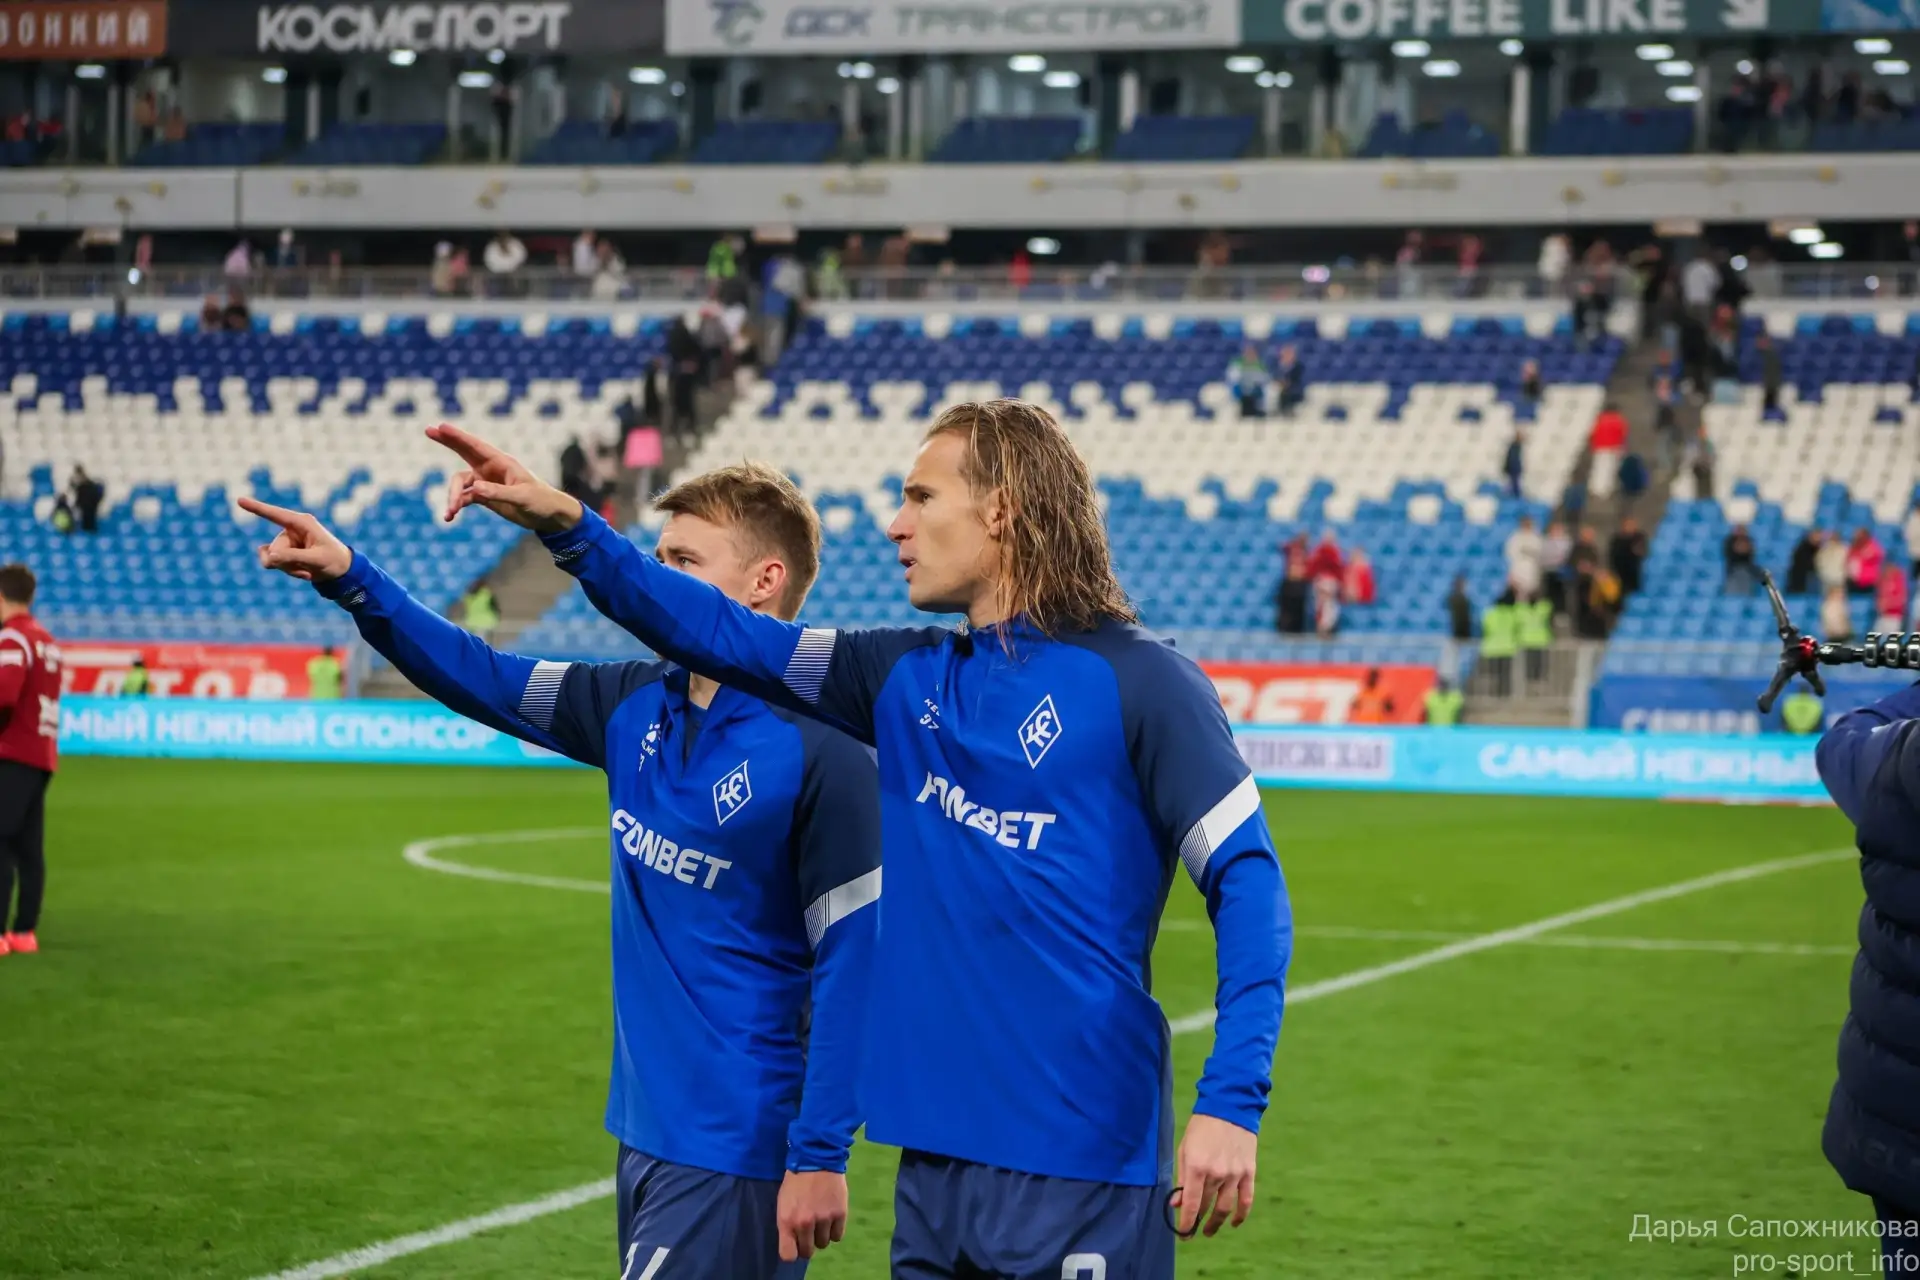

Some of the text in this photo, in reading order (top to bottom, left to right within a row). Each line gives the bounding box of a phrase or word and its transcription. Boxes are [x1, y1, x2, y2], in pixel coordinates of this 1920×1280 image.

[258, 3, 571, 52] КОСМСПОРТ
[1284, 0, 1686, 39] COFFEE LIKE
[62, 704, 147, 741] МЫЙ
